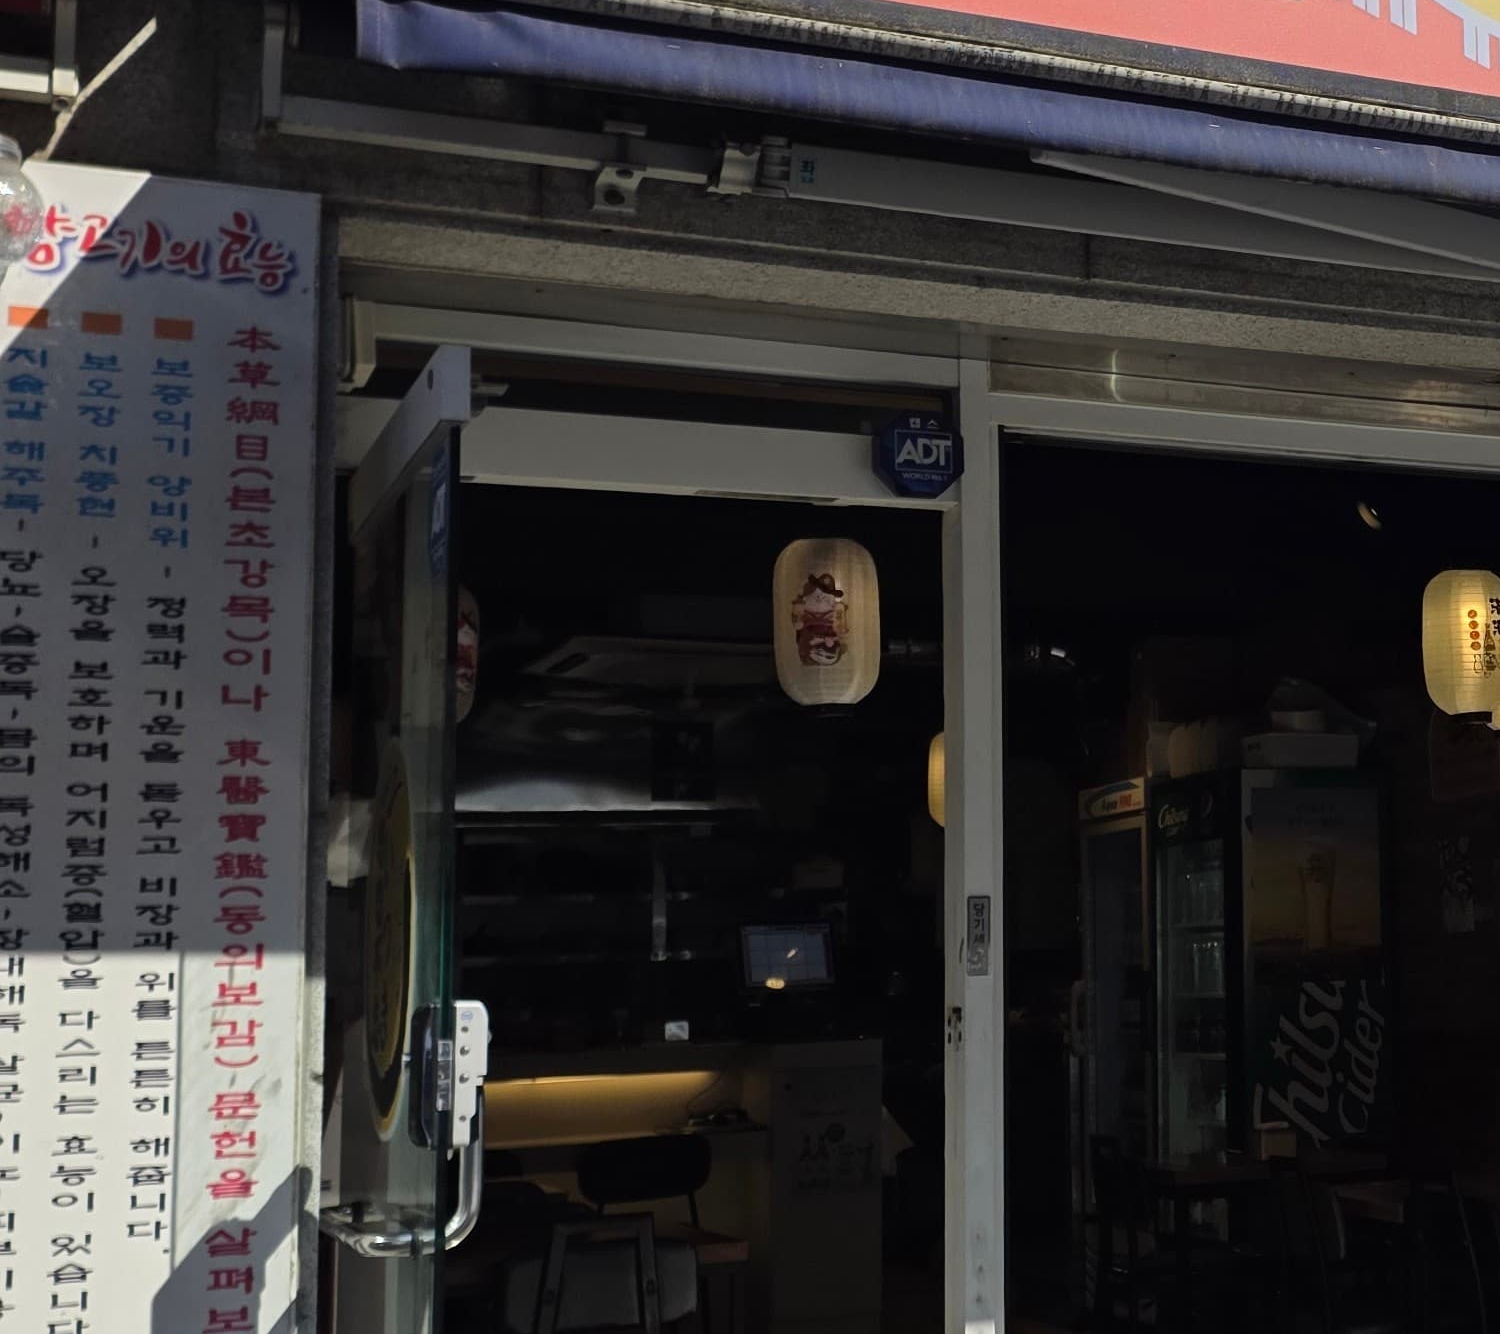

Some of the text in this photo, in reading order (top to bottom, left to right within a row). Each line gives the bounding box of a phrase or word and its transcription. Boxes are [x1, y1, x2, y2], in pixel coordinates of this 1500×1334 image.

[216, 210, 293, 290] 효능
[896, 437, 952, 467] ADT
[147, 475, 192, 549] 양비위
[70, 566, 117, 643] 오장을
[140, 596, 187, 670] 정력과
[66, 661, 114, 762] 보호하며
[139, 690, 185, 763] 기운을
[132, 877, 179, 951] 비장과
[131, 971, 176, 1021] 위를
[54, 1010, 101, 1115] 다스리는
[129, 1041, 174, 1115] 튼튼히
[50, 1135, 98, 1213] 효능이
[205, 1091, 261, 1200] 문헌을
